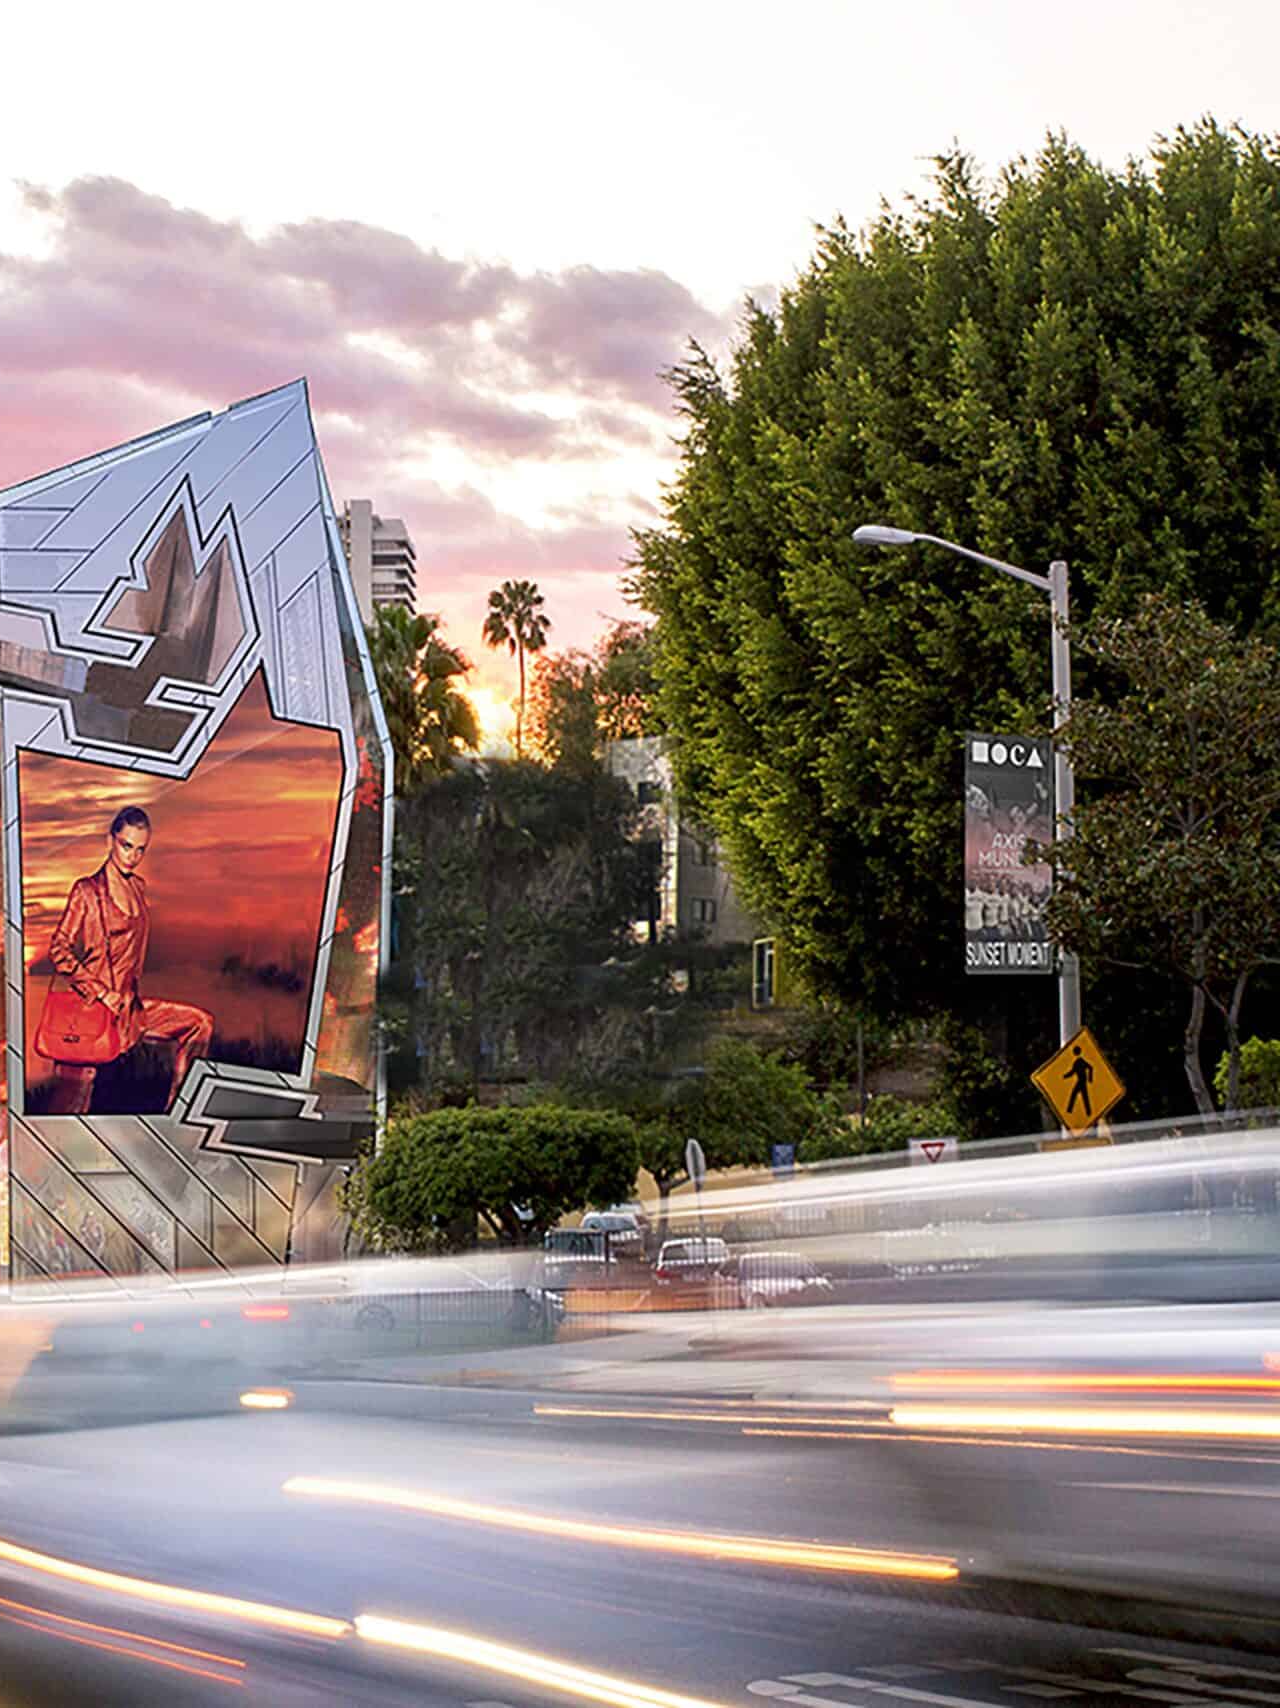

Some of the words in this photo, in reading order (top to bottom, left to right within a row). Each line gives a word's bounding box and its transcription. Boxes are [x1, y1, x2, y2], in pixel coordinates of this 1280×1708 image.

[991, 832, 1027, 849] AXIS
[965, 942, 1005, 966] SUNSET
[1007, 942, 1050, 966] MOMENT
